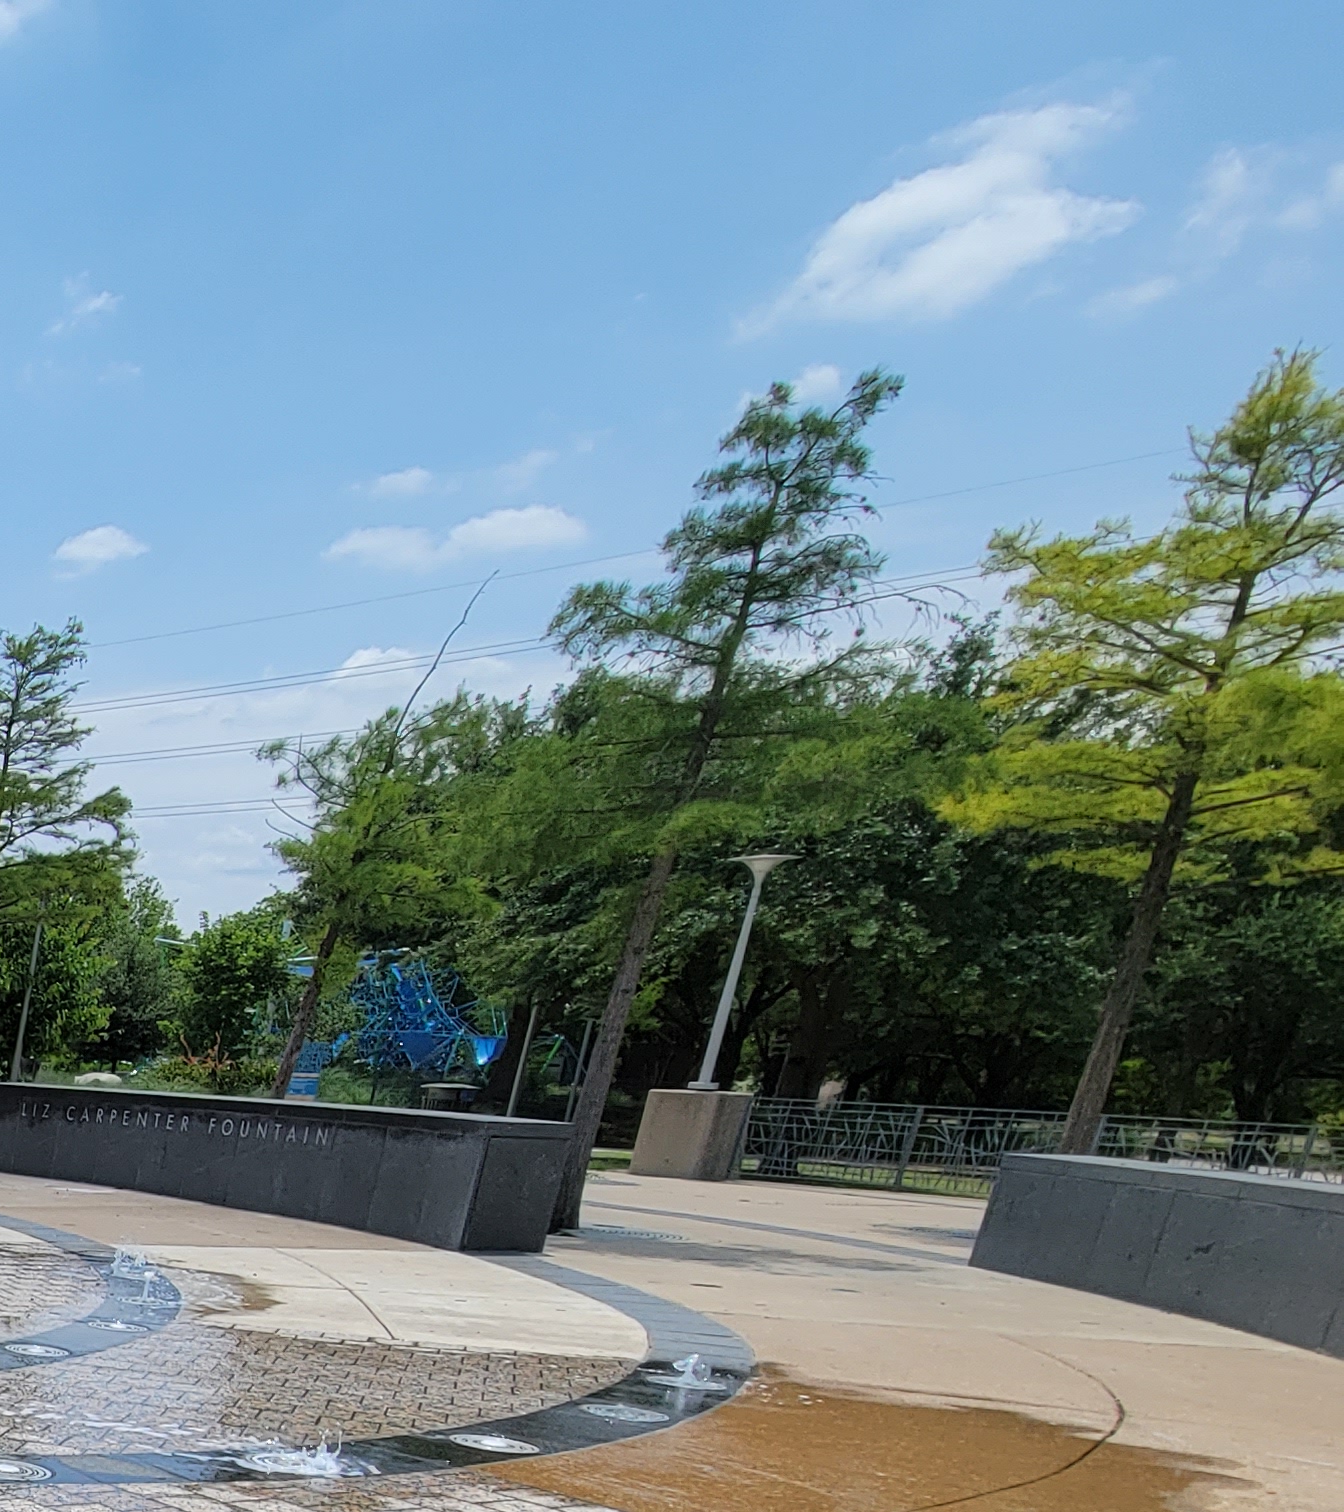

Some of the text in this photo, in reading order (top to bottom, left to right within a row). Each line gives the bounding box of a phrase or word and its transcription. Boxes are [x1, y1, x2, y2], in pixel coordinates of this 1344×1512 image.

[21, 1103, 329, 1146] LIZ CARPENTER FOUNTAIN
